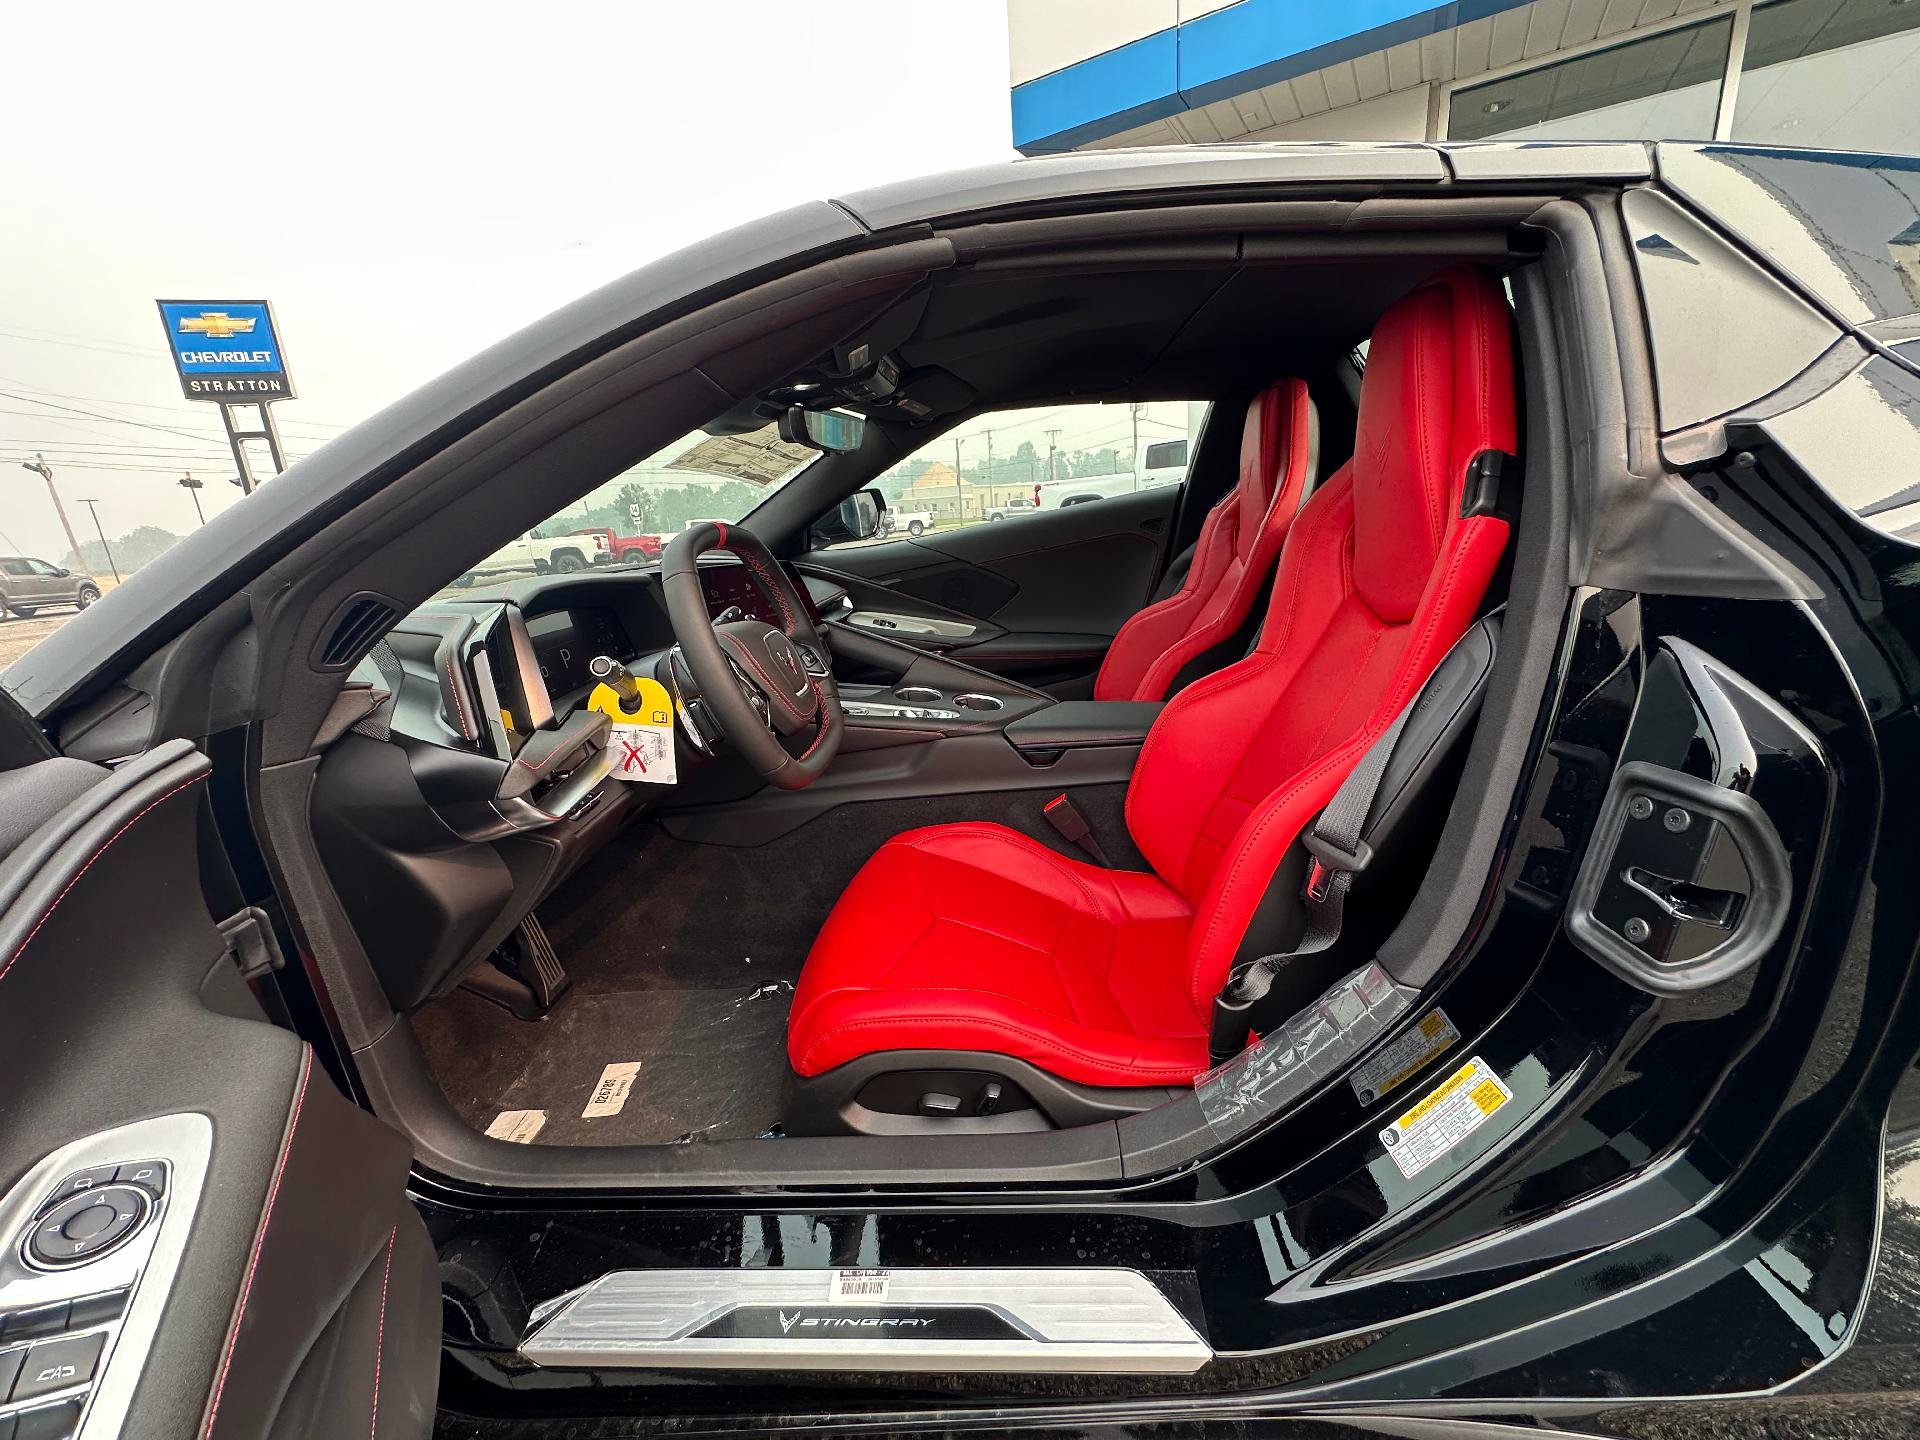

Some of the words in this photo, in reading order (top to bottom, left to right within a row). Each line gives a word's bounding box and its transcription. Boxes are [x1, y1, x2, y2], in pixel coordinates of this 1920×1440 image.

[181, 351, 271, 363] CHEVROLET
[190, 380, 281, 392] STRATTON
[560, 649, 571, 669] P
[799, 1318, 937, 1327] STINGRAY
